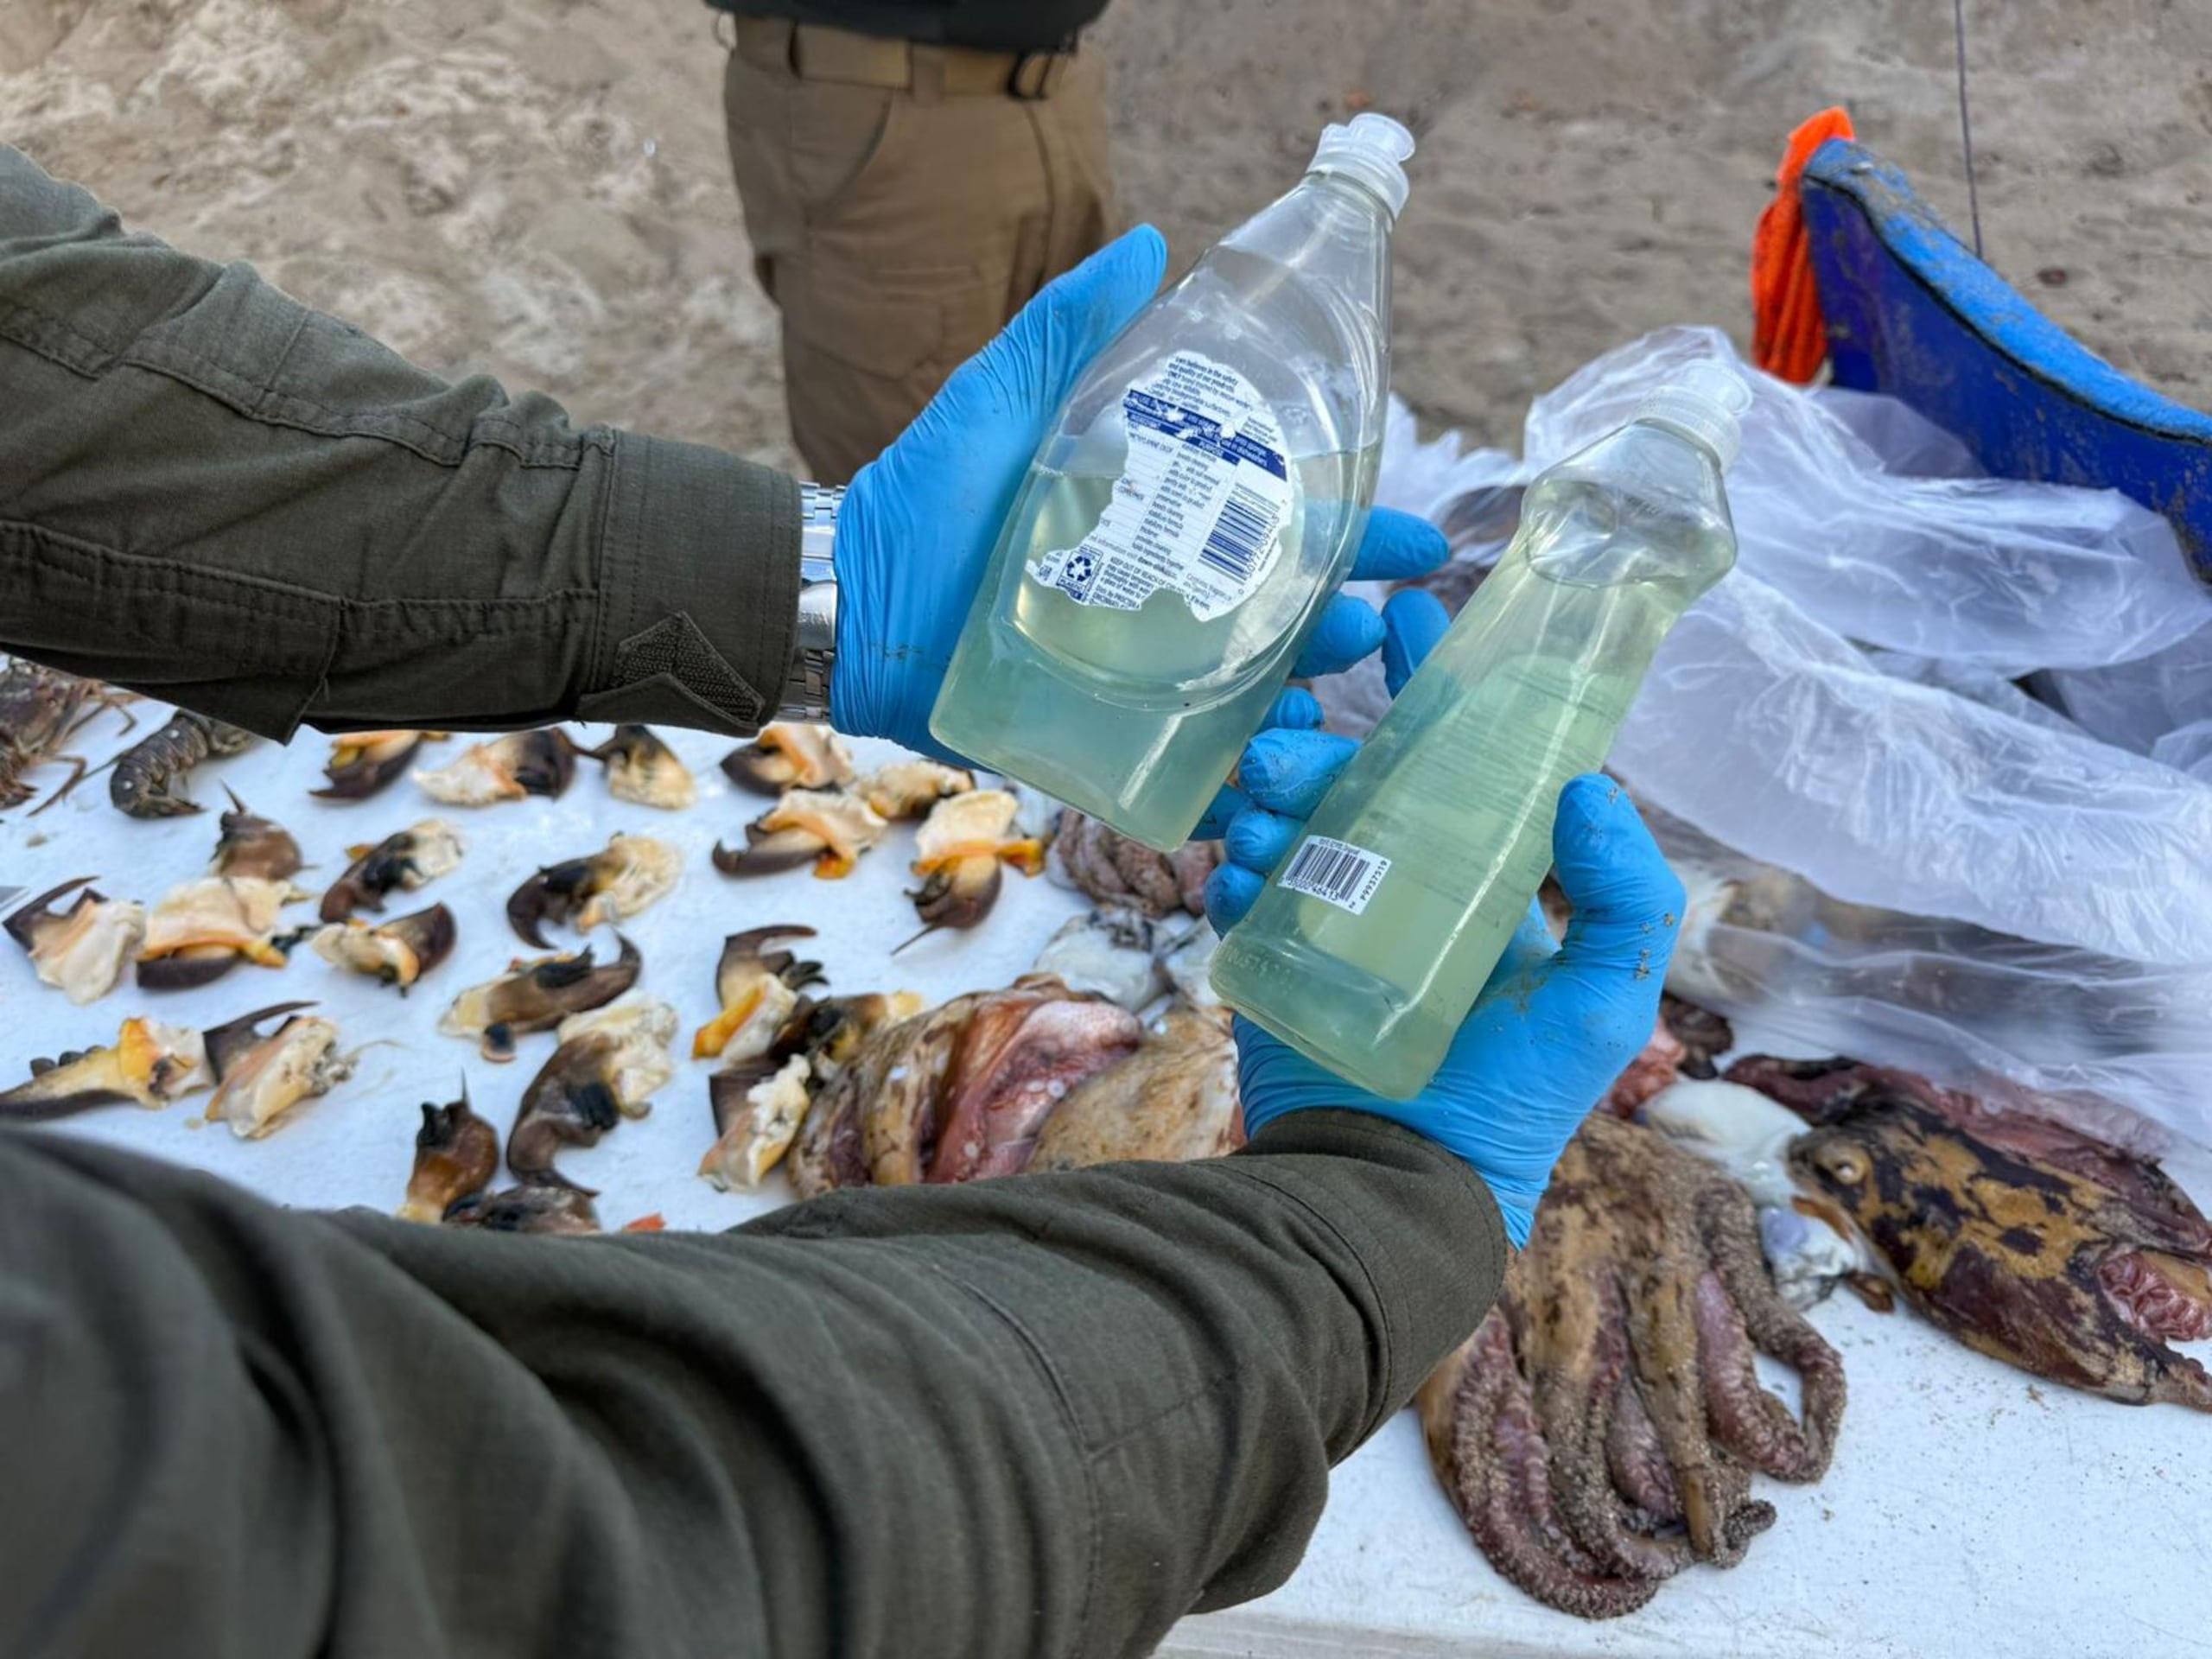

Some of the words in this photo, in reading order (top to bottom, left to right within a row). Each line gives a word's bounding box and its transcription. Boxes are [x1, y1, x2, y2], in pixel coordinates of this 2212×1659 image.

[1179, 365, 1195, 377] quality
[1222, 374, 1238, 385] safety
[1110, 556, 1122, 565] KEEP
[1141, 571, 1158, 582] REACH
[1060, 579, 1082, 590] PLASTIC
[1360, 860, 1387, 900] P9937519
